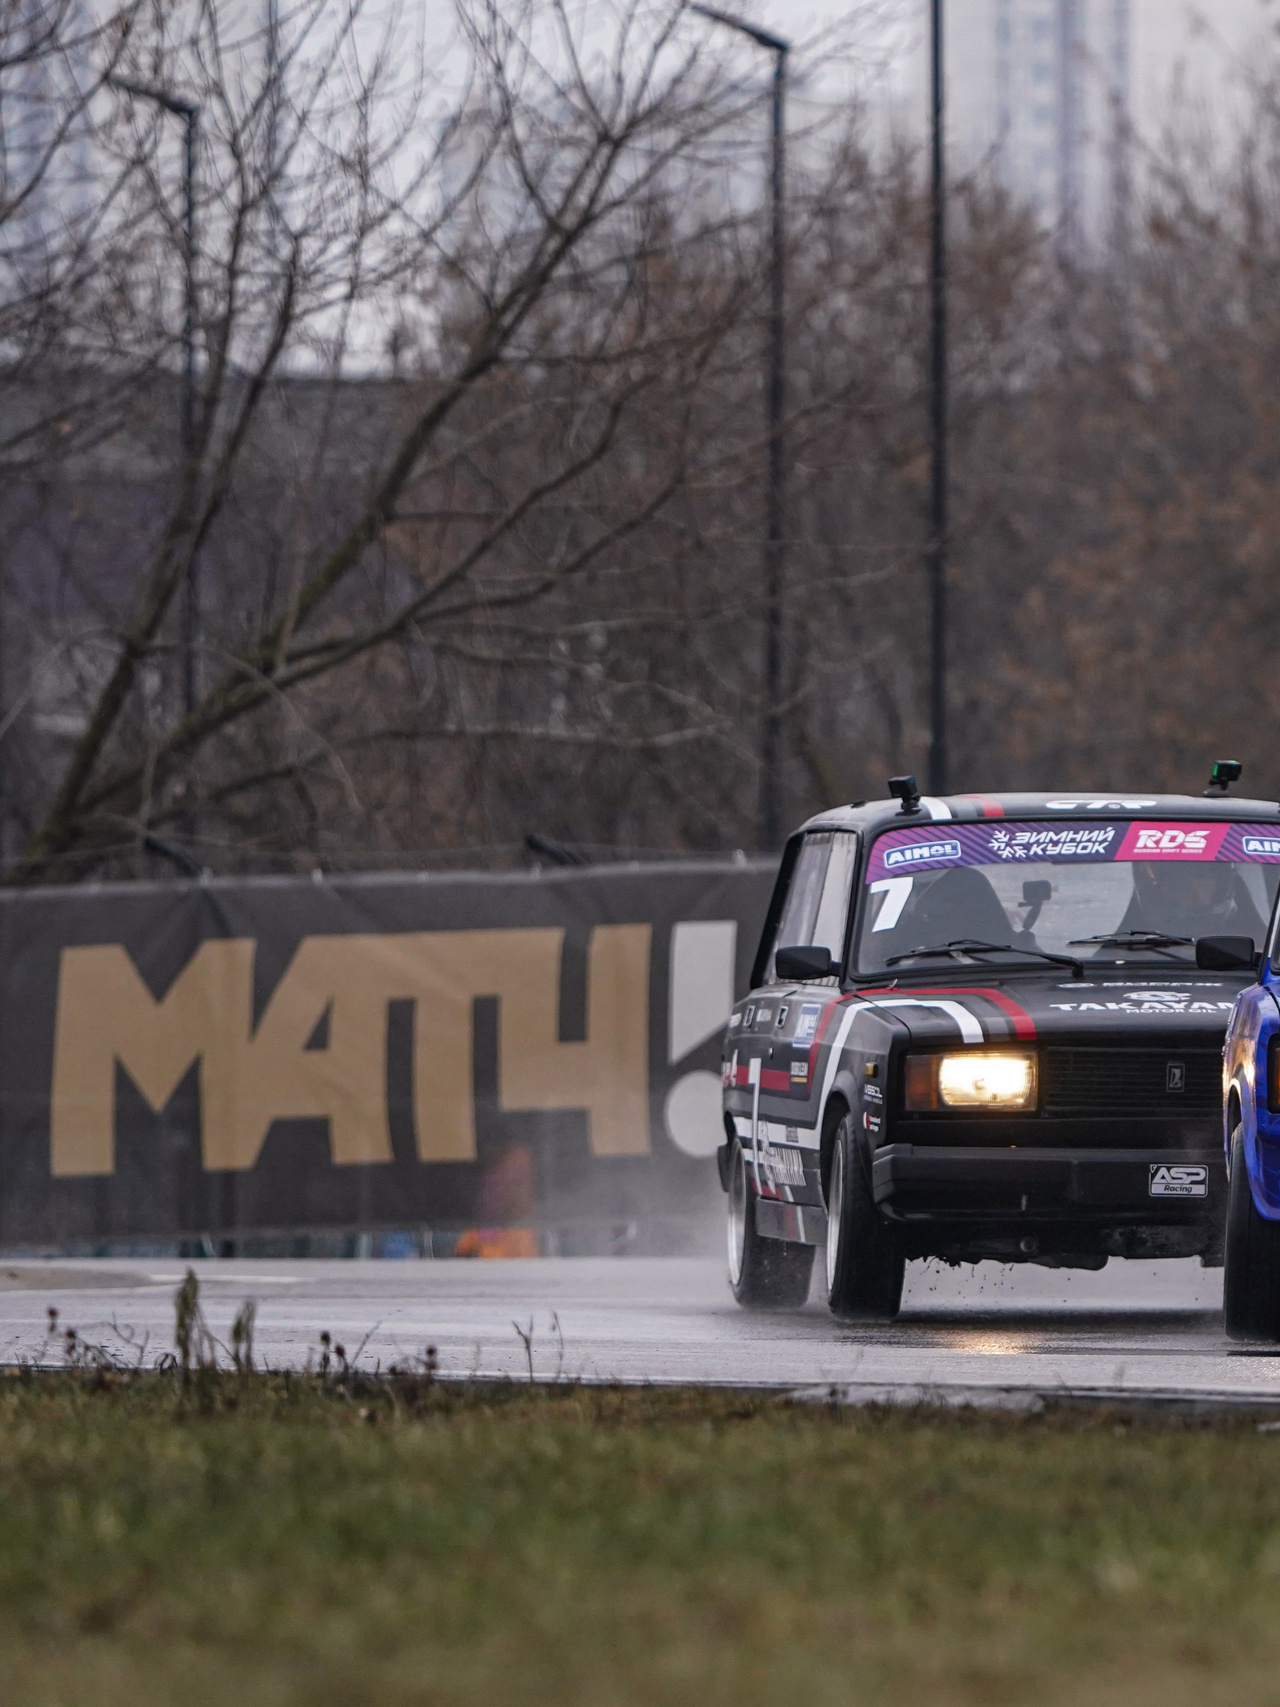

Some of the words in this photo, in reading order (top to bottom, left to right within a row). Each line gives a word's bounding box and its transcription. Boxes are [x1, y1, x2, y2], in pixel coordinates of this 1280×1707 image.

[1012, 826, 1116, 843] ЗИМНИЙ
[1135, 829, 1211, 848] RDS
[888, 843, 957, 865] AIMOL
[1029, 842, 1113, 855] КУБОК
[870, 877, 914, 933] 7
[1049, 1001, 1236, 1011] TAKAYA
[1152, 1166, 1206, 1184] ASP
[1164, 1184, 1193, 1194] Racing
